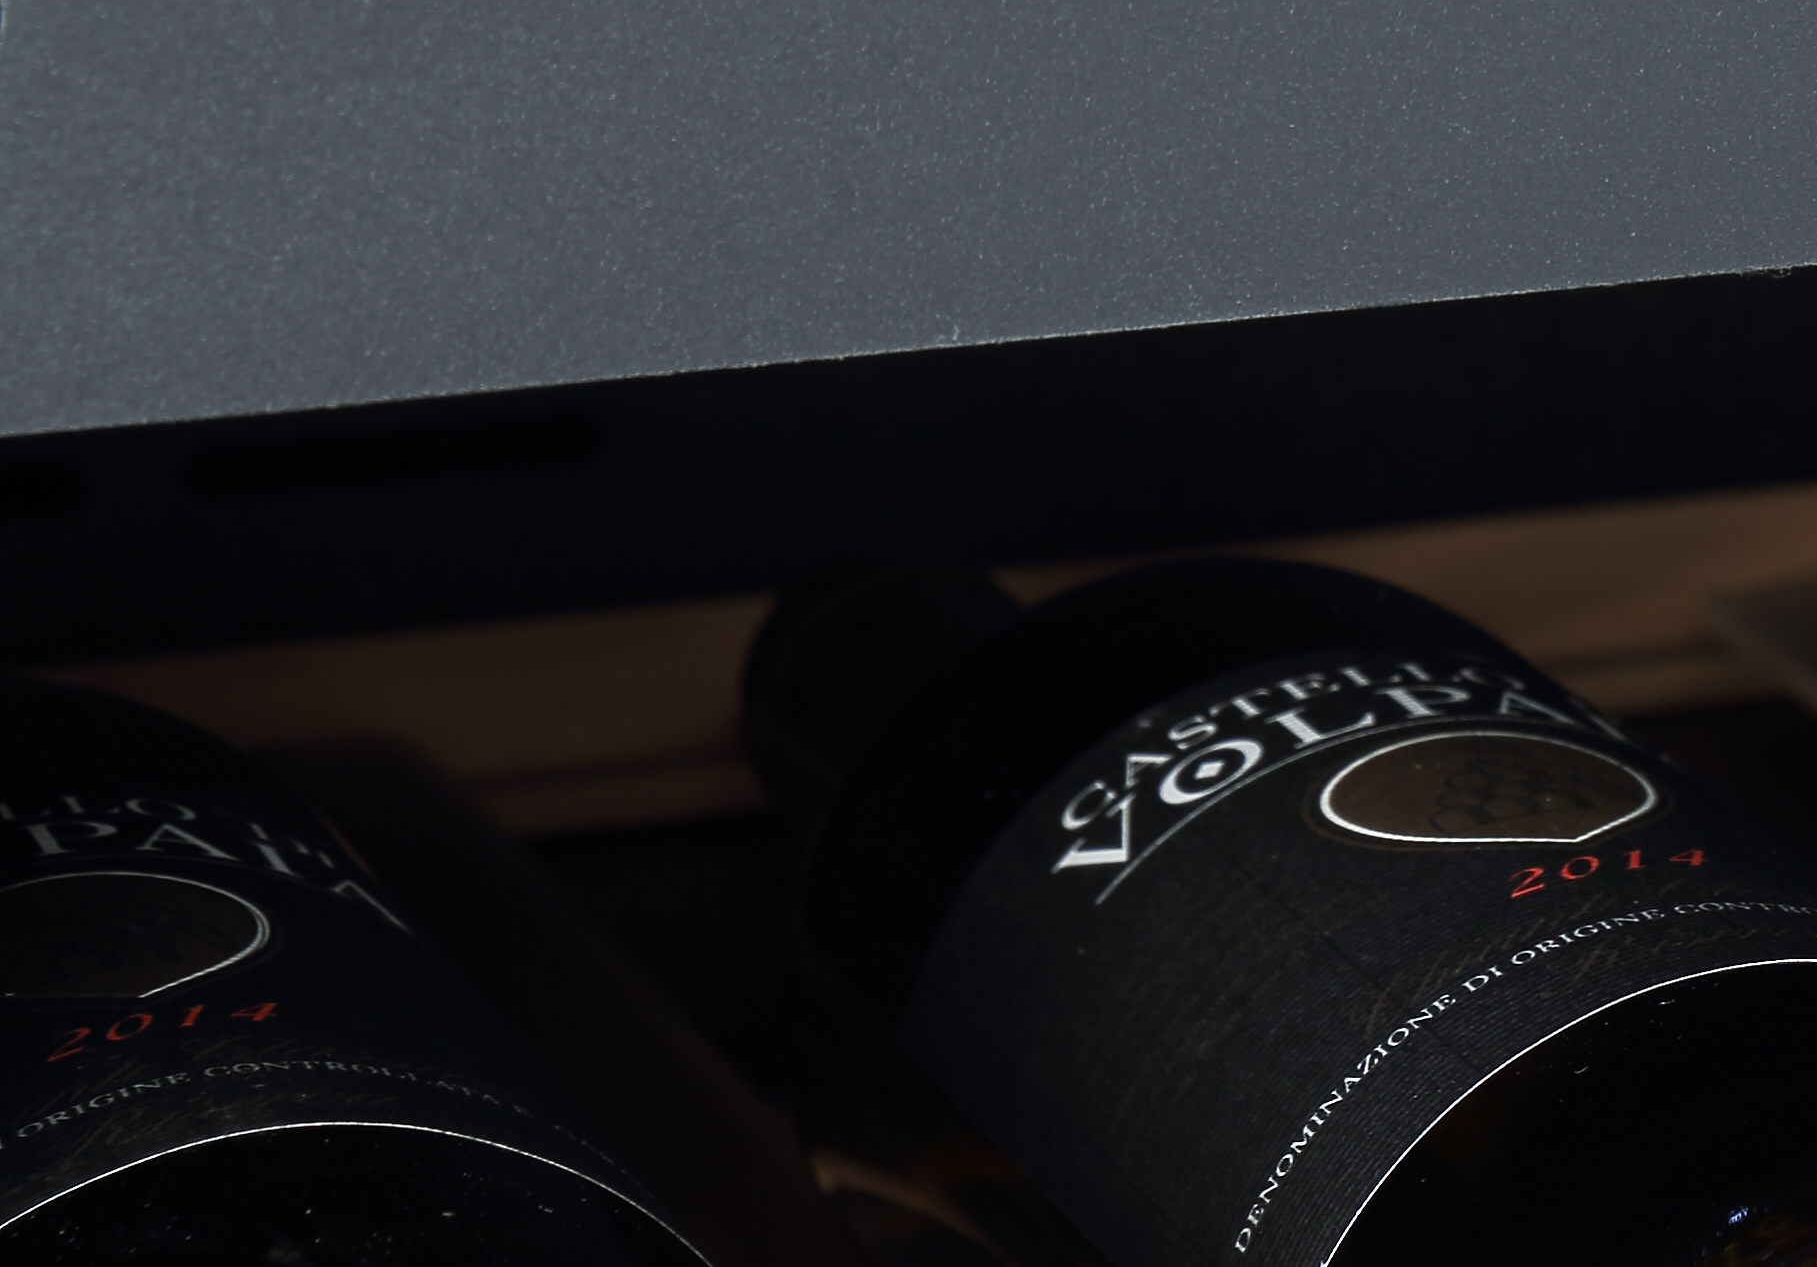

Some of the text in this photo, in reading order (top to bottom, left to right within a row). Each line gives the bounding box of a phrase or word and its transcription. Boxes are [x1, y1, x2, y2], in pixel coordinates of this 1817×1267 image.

[1507, 848, 1709, 900] 2014
[45, 1001, 279, 1063] 2014
[16, 1071, 191, 1138] ORIGINE
[1234, 994, 1457, 1254] DENOMINAZIONE
[1461, 964, 1504, 994] DI
[1510, 907, 1666, 966] ORIGINE
